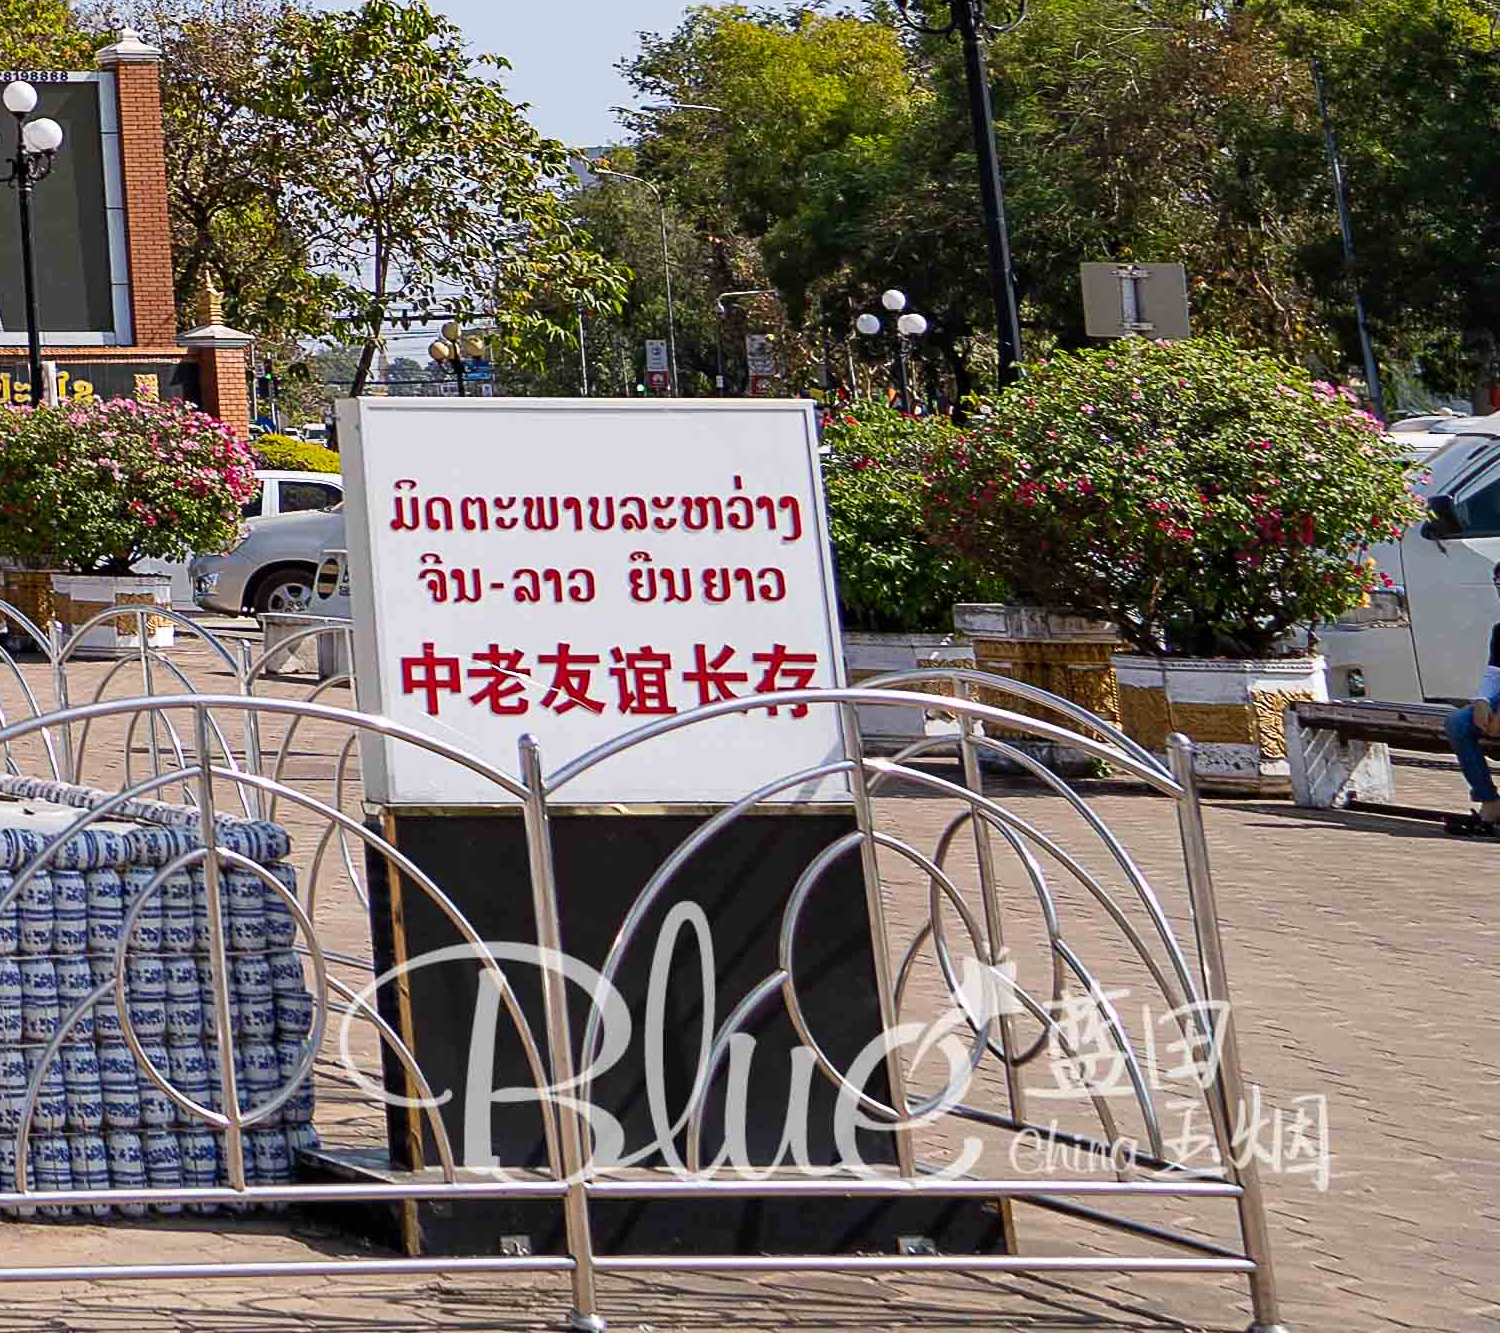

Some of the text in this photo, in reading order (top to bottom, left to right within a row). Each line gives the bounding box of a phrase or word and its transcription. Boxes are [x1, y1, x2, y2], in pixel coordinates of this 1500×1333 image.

[389, 476, 802, 541] ມິດຕະພາບລະຫວ່າງ
[400, 642, 820, 718] 中老友谊长存
